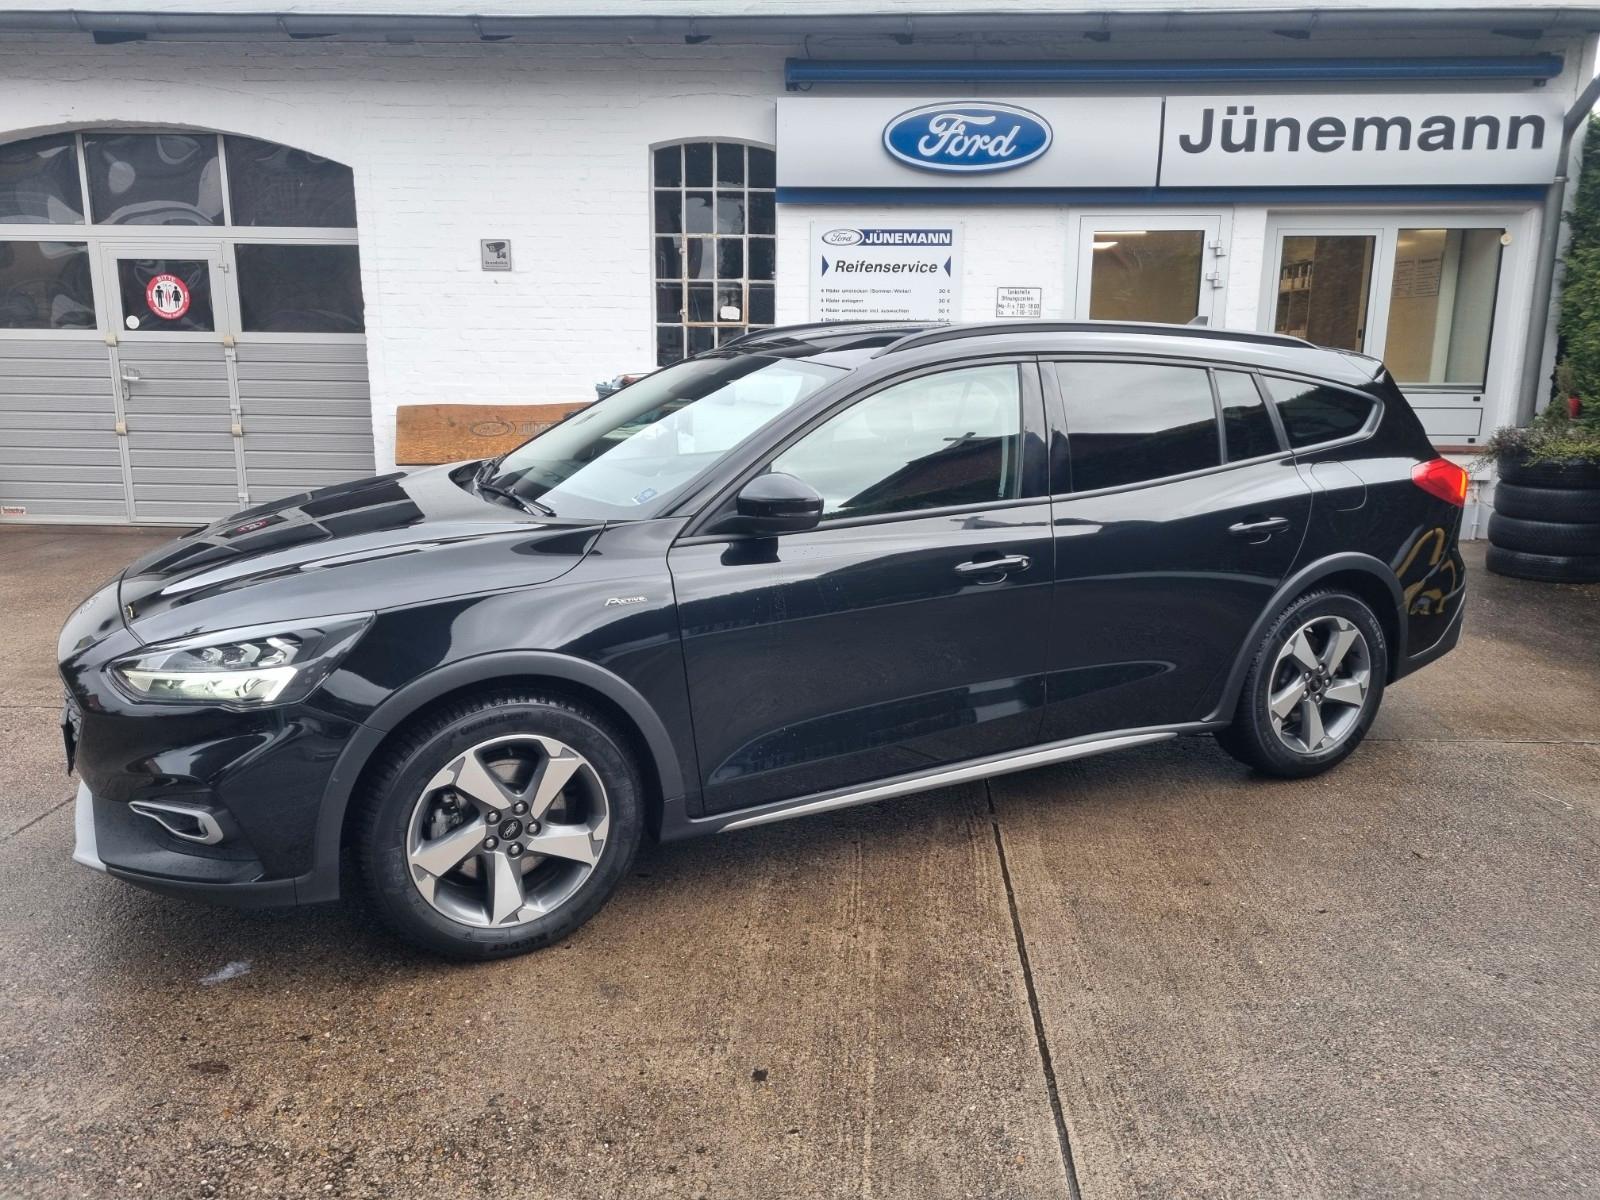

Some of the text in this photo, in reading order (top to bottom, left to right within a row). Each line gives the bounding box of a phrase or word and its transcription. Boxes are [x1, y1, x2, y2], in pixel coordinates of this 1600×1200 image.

[918, 113, 1021, 157] Ford
[1179, 105, 1546, 154] Jünemann
[830, 230, 951, 244] Ford JÜNEMANN
[835, 260, 938, 273] Reifenservice
